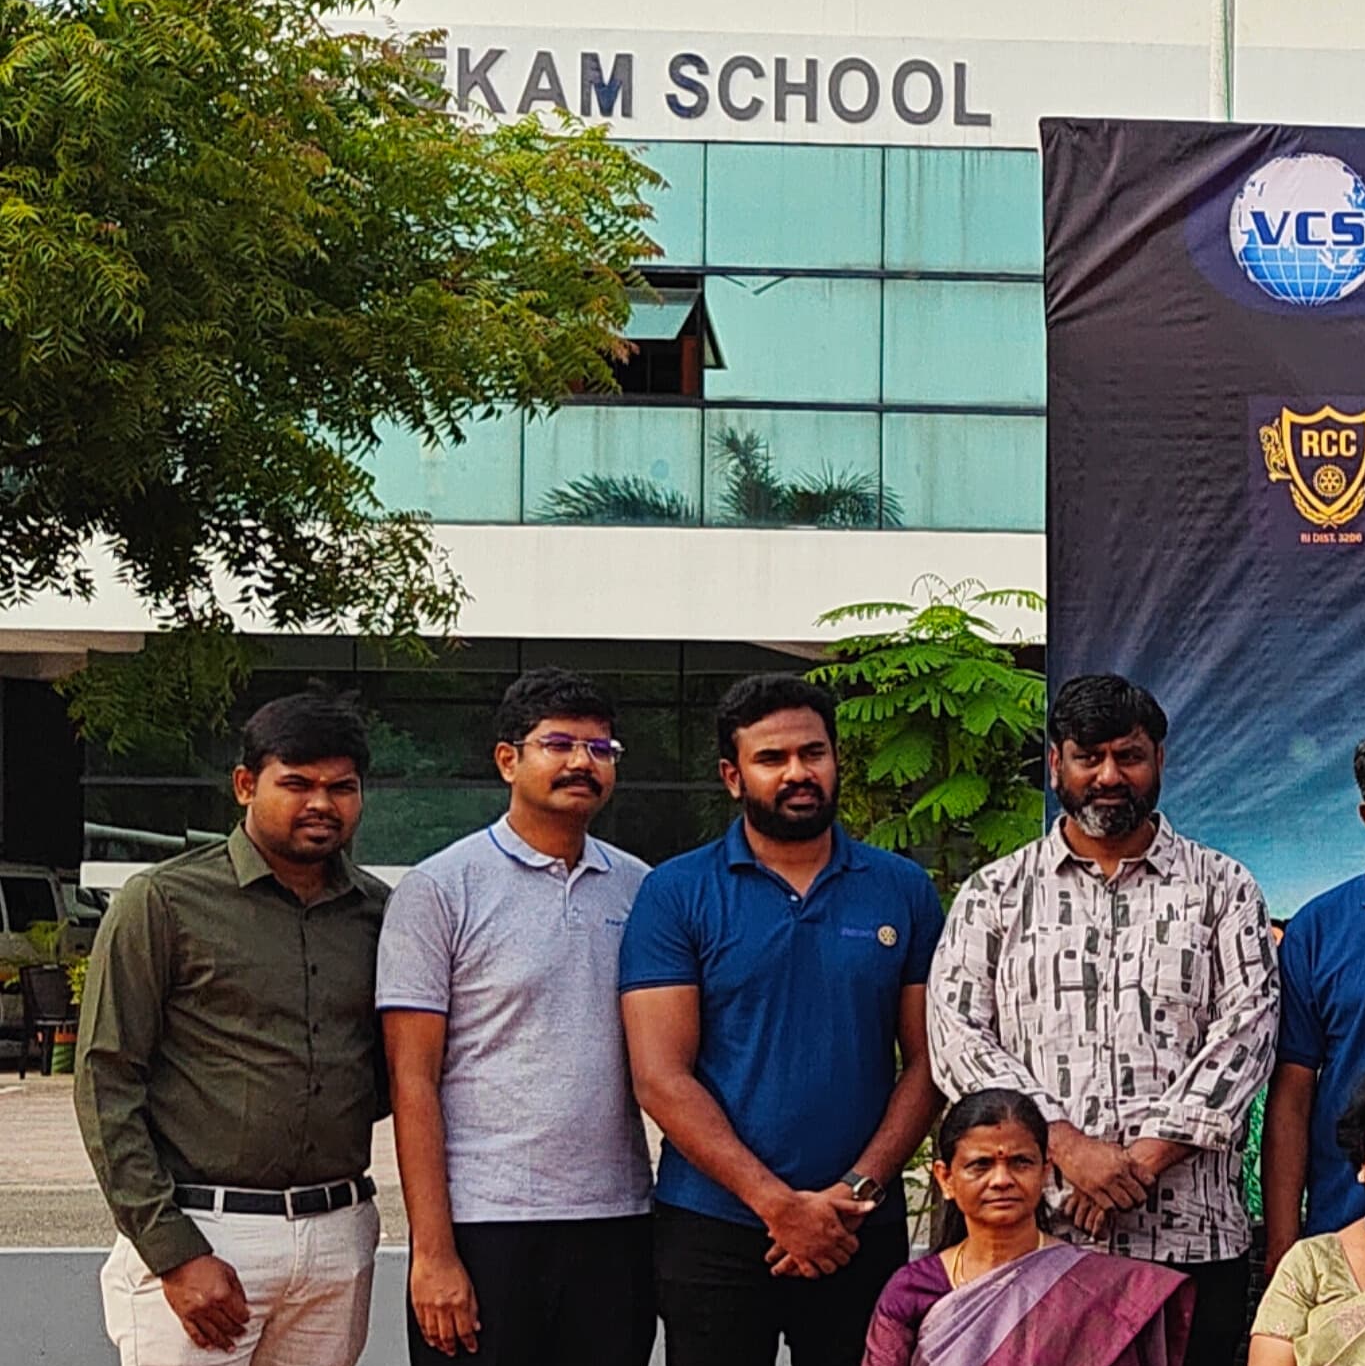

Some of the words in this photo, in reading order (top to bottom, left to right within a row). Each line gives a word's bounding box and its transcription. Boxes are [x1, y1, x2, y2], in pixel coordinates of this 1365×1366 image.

[400, 45, 633, 119] EKAM
[664, 52, 992, 127] SCHOOL
[1250, 210, 1365, 247] VCS
[1302, 429, 1356, 457] RCC
